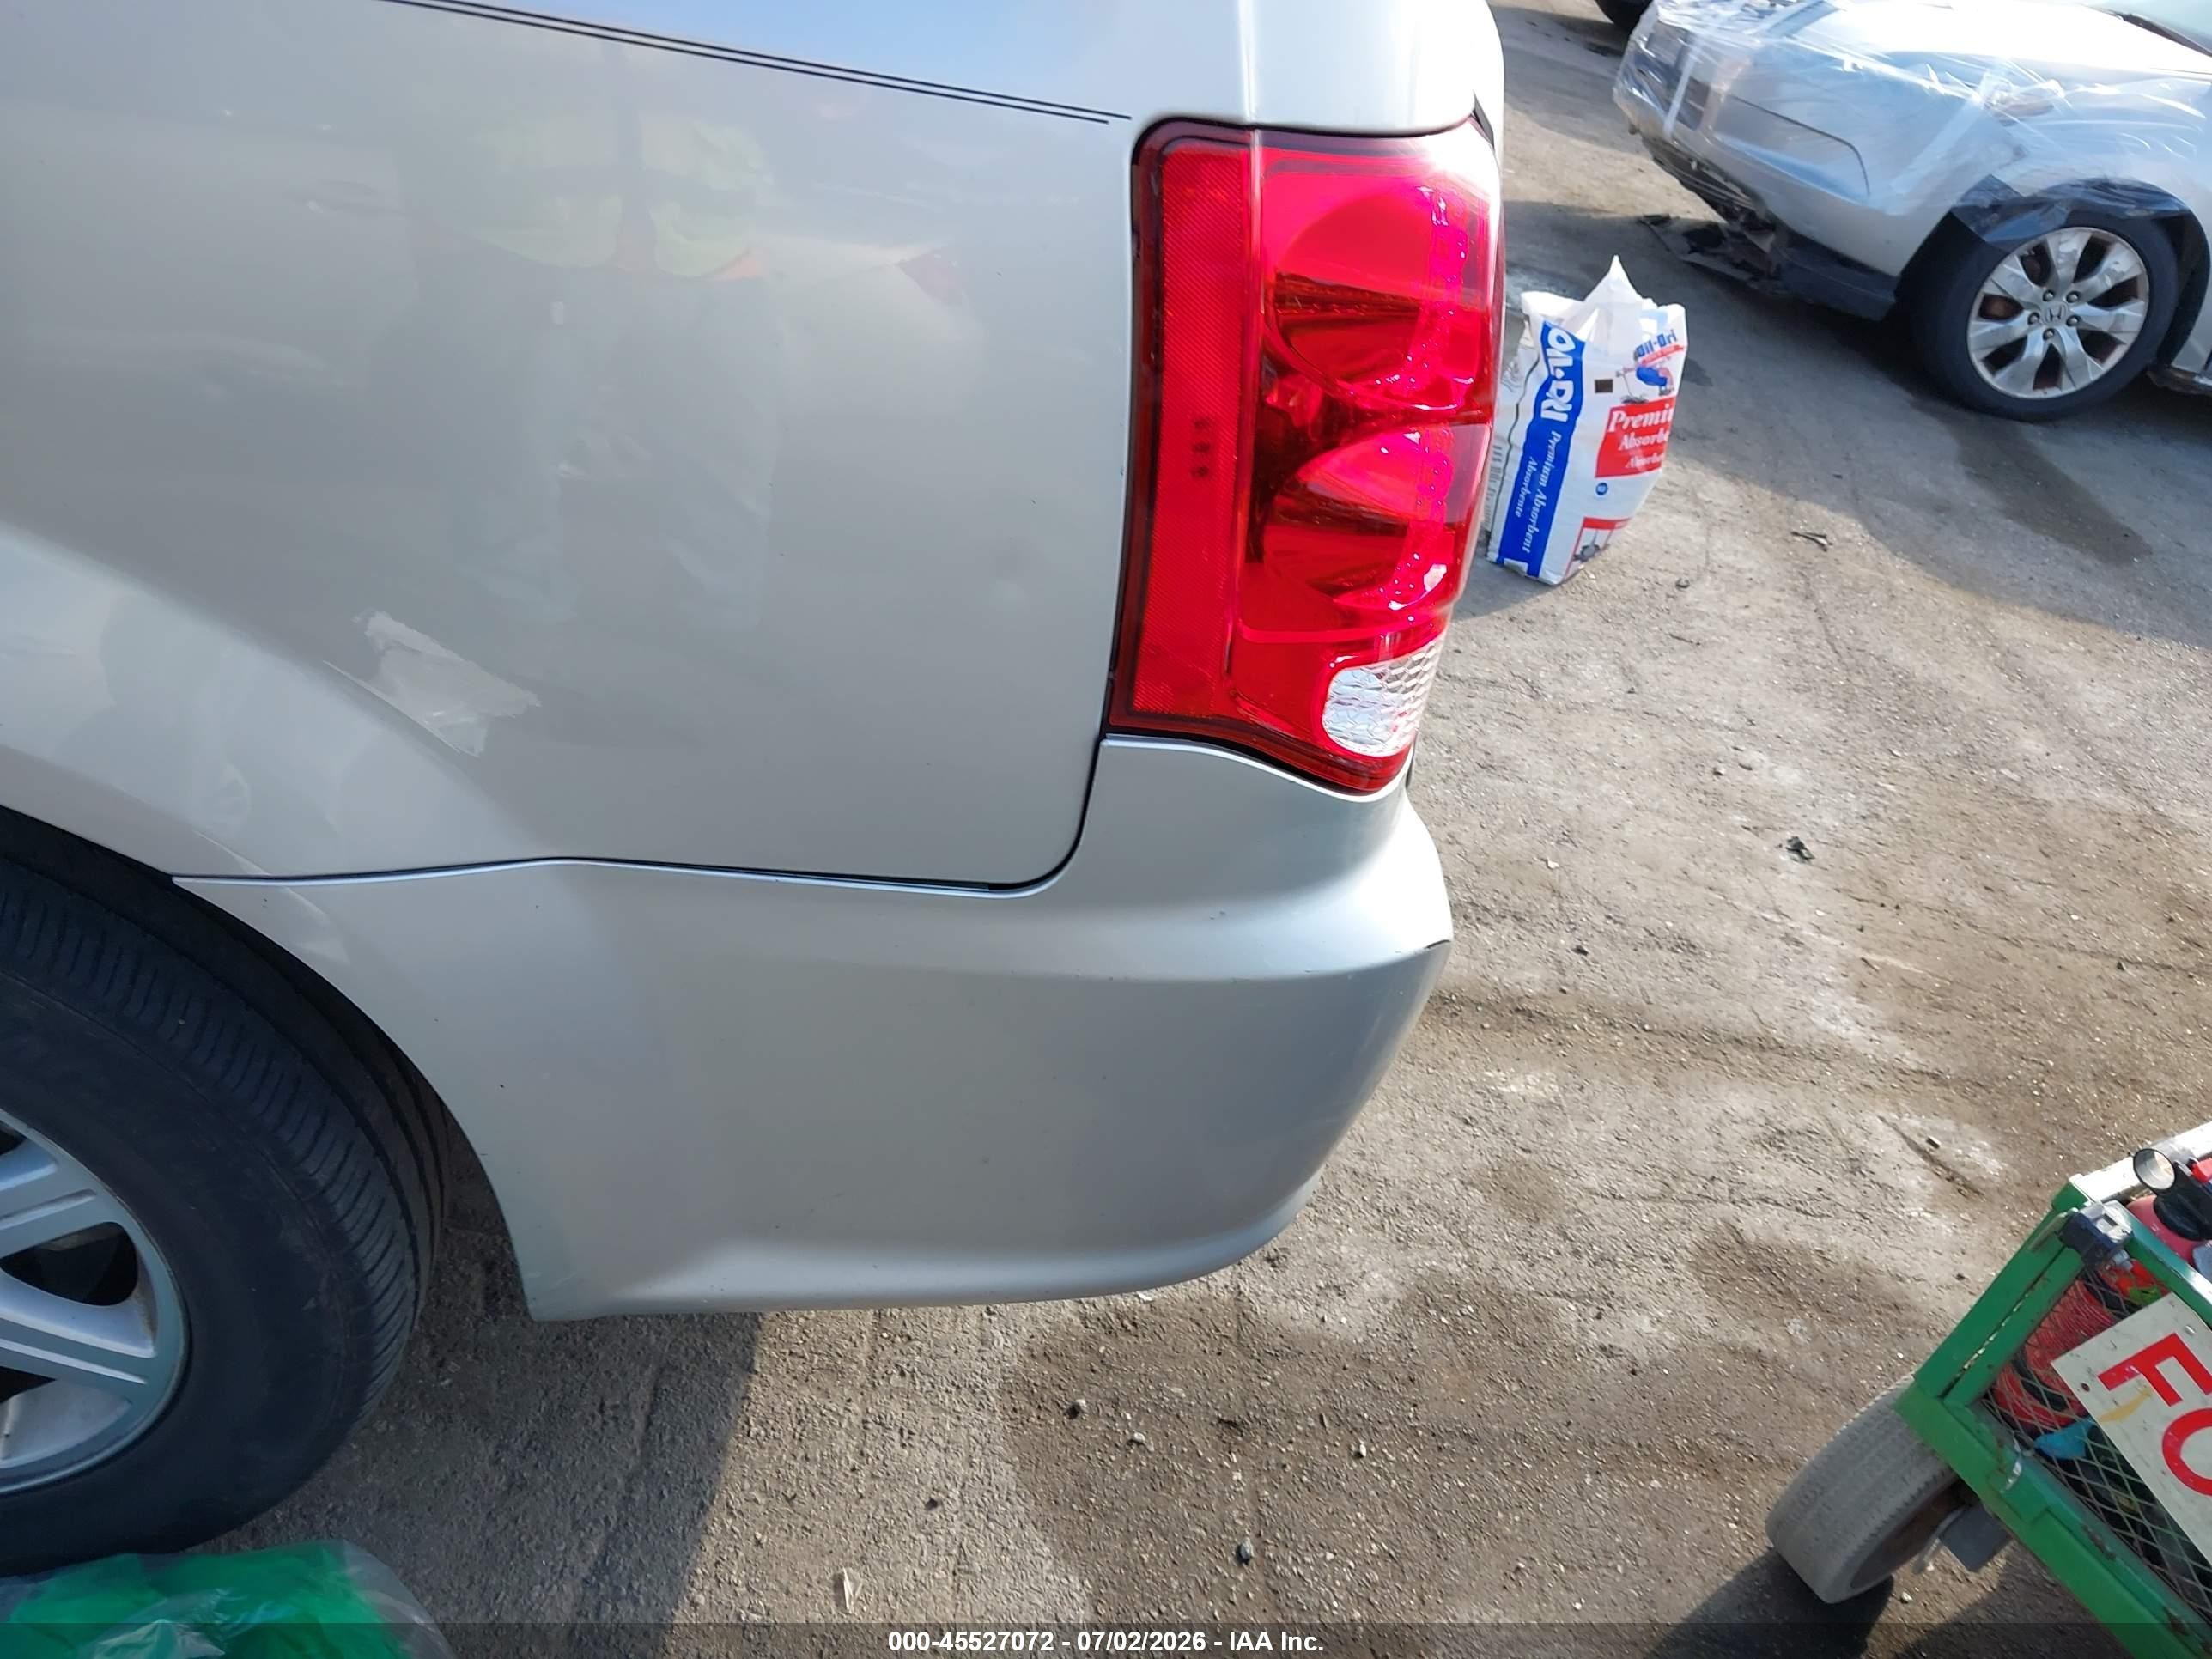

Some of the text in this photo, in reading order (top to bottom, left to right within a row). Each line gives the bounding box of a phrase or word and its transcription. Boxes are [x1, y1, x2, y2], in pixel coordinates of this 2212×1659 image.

[1515, 456, 1538, 518] Absorbente
[1522, 430, 1562, 553] Premium Absorbent
